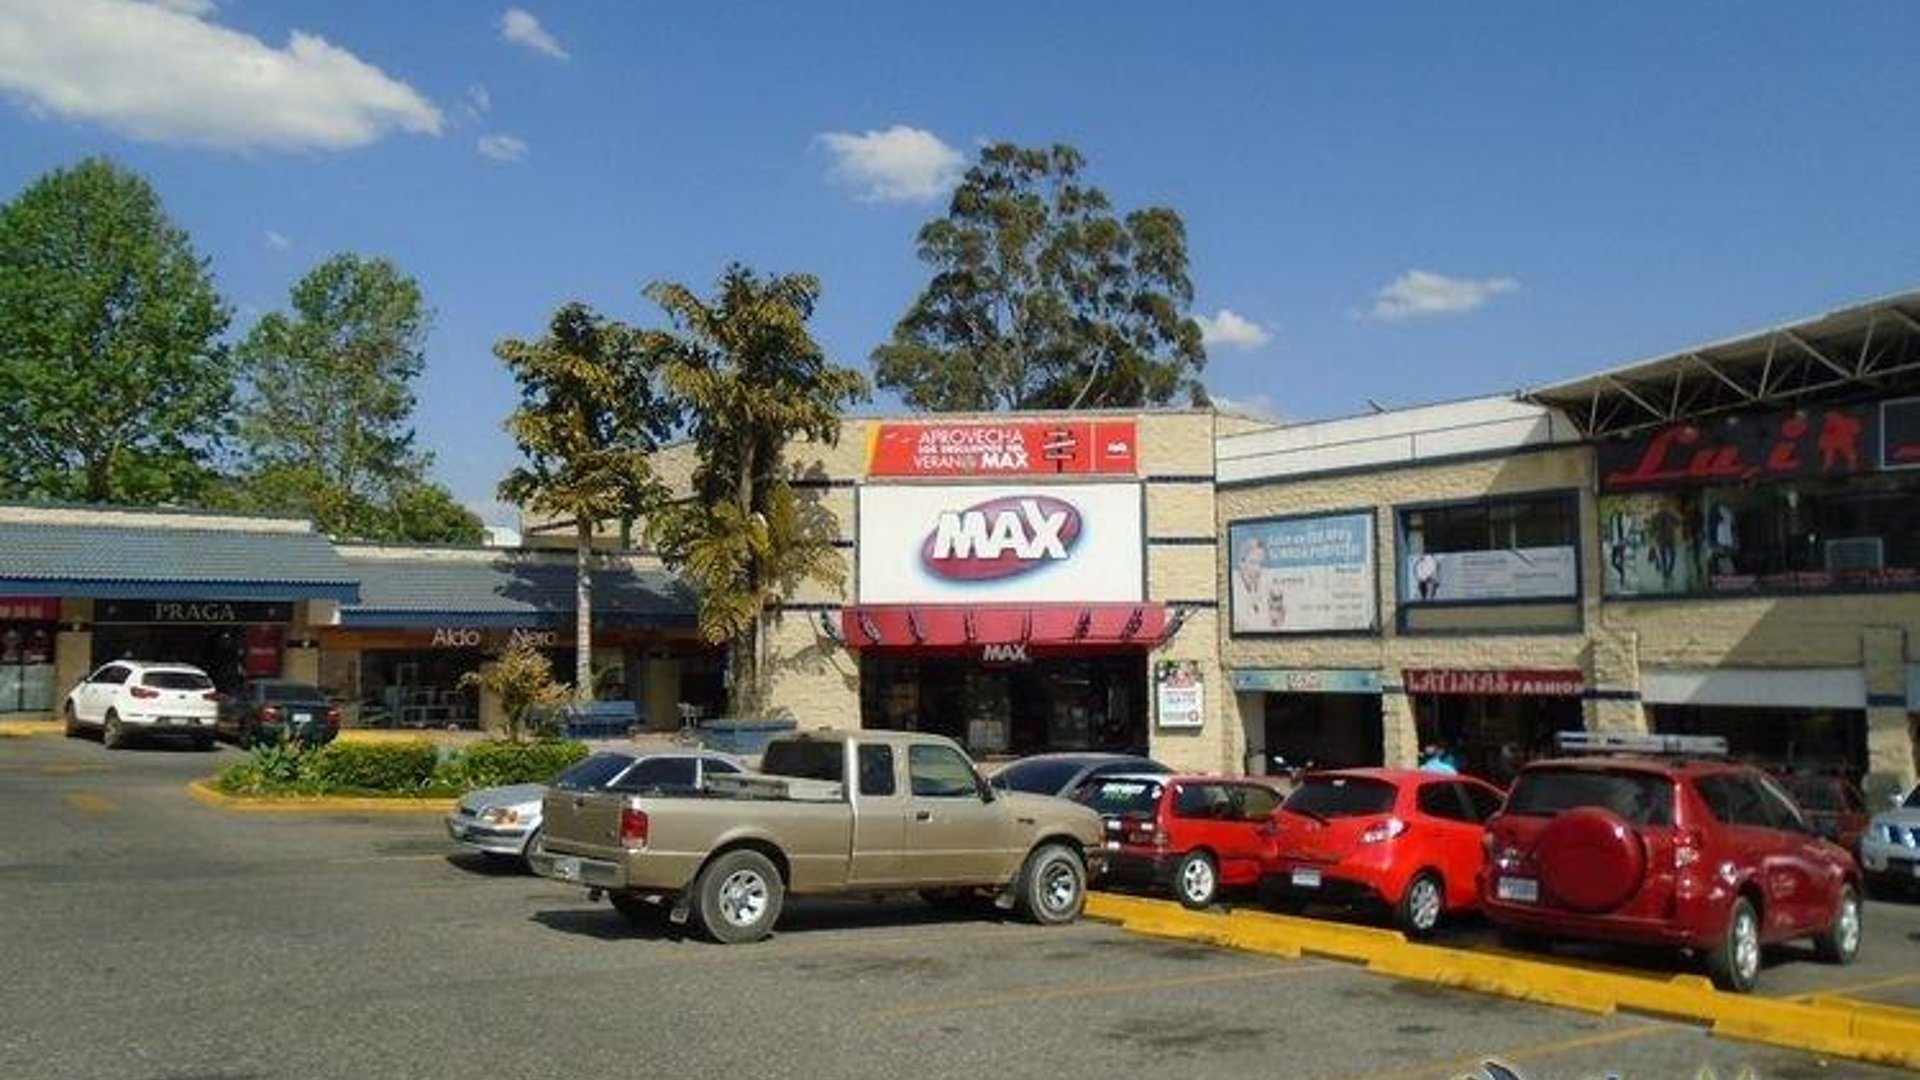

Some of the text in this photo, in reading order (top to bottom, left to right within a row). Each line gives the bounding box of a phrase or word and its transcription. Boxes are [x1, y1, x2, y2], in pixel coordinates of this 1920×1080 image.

[918, 428, 1025, 444] APROVECHA
[913, 452, 1029, 470] VERAN MAX
[932, 499, 1070, 560] MAX
[154, 602, 236, 622] PRAGA
[431, 627, 480, 647] Aldo
[983, 643, 1027, 662] MAX
